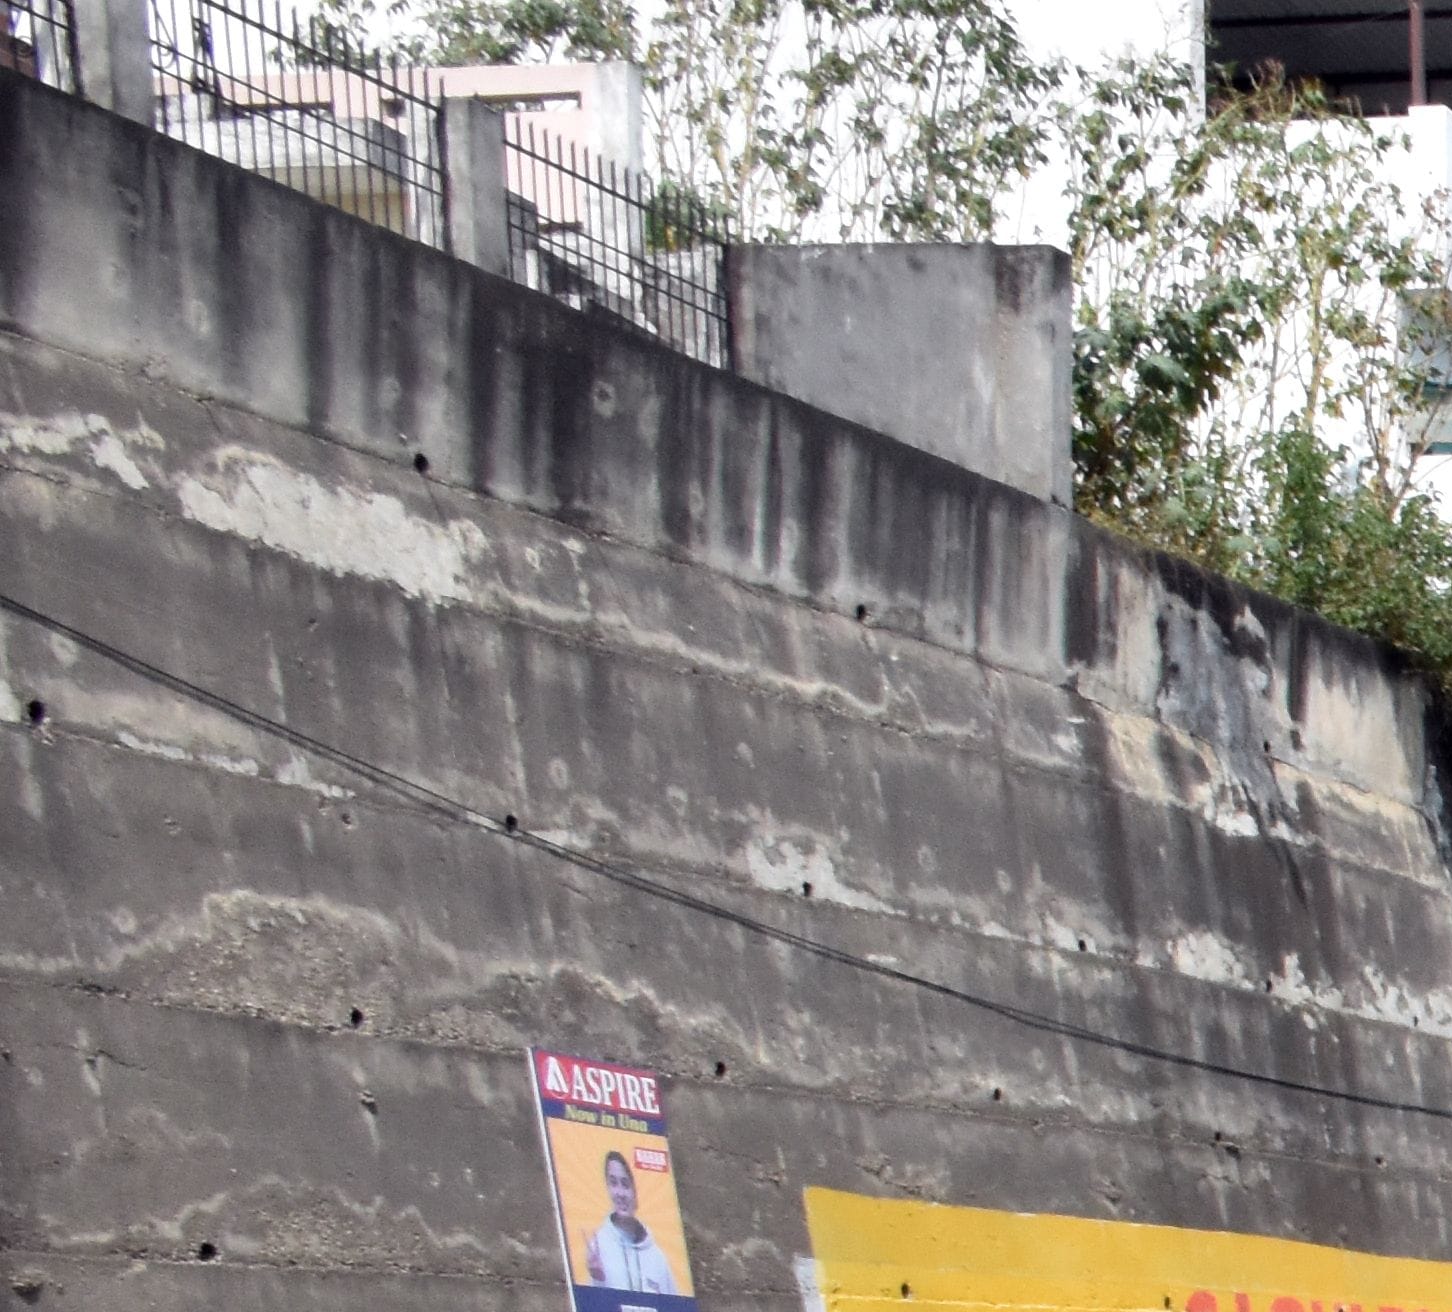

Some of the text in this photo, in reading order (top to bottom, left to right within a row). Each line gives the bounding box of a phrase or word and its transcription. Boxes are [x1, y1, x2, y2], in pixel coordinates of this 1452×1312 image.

[572, 1064, 660, 1114] ASPIRE
[565, 1104, 648, 1132] Now in Una
